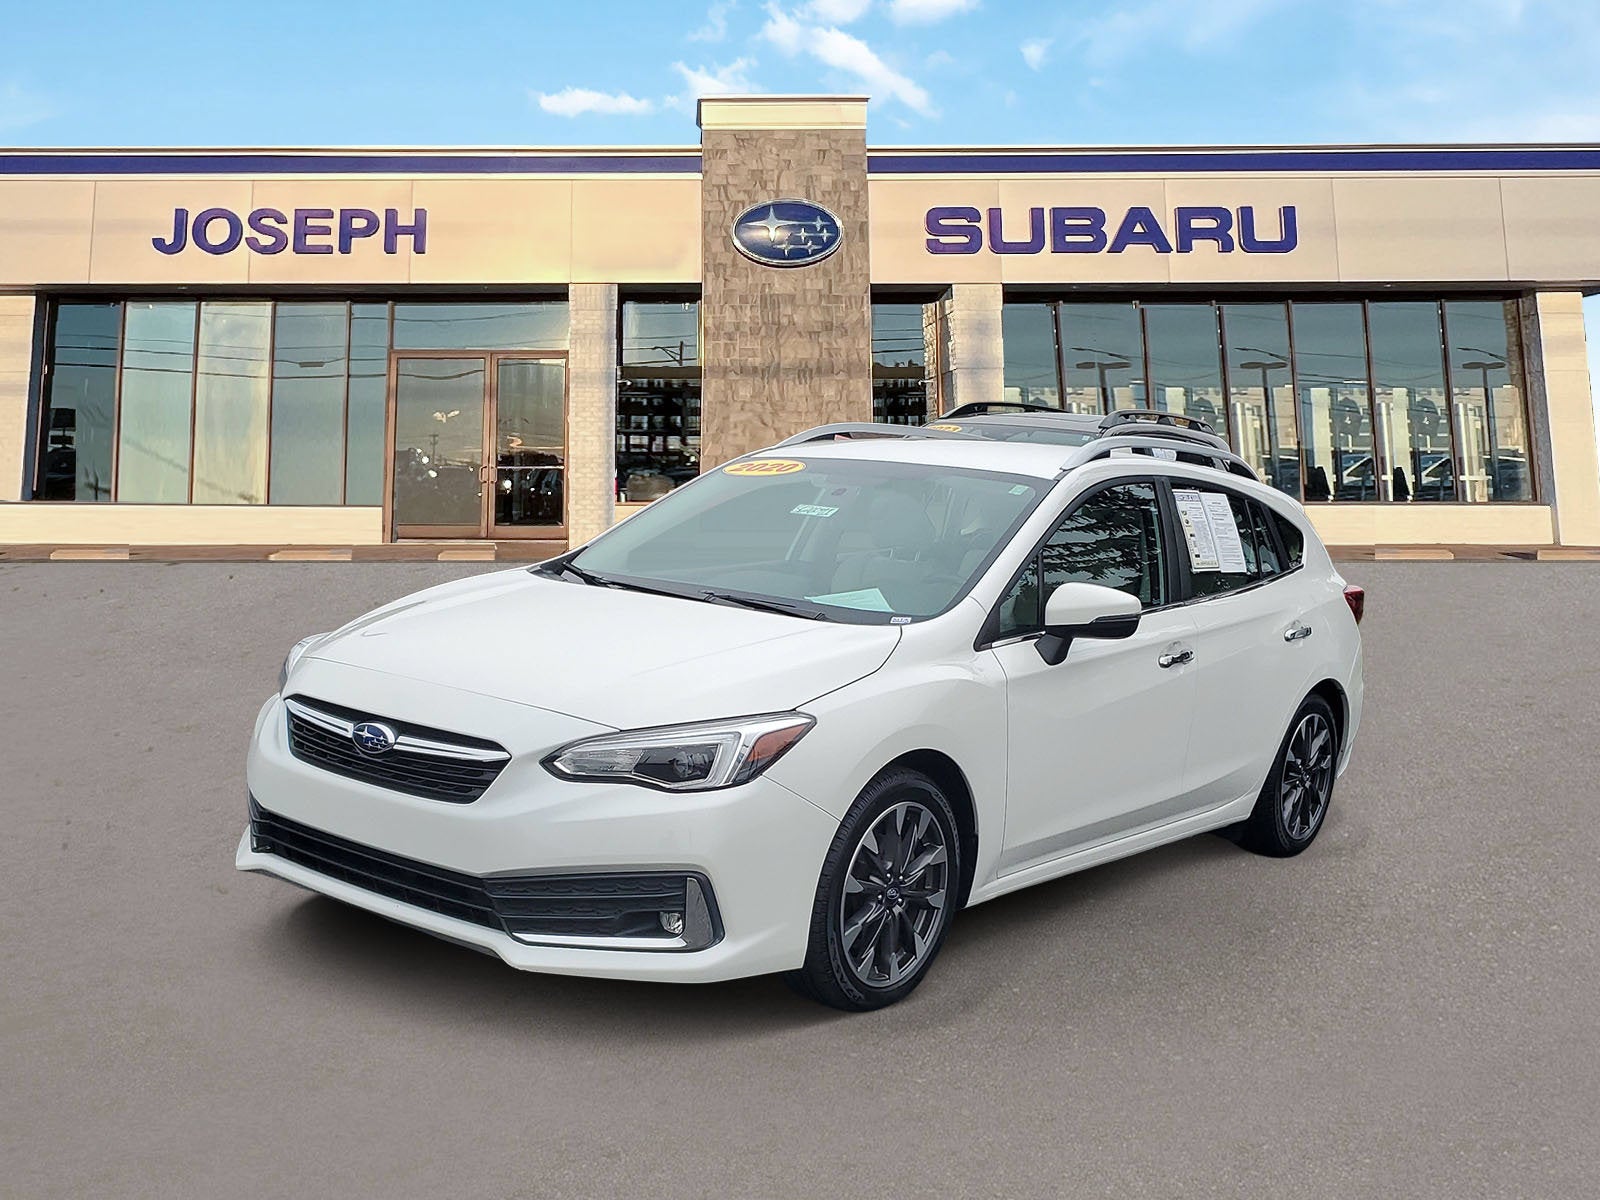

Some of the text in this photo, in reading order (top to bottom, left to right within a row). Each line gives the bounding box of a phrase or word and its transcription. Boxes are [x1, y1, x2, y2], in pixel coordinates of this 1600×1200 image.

[152, 208, 427, 254] JOSEPH
[925, 206, 1298, 254] SUBARU
[729, 462, 799, 473] 2020
